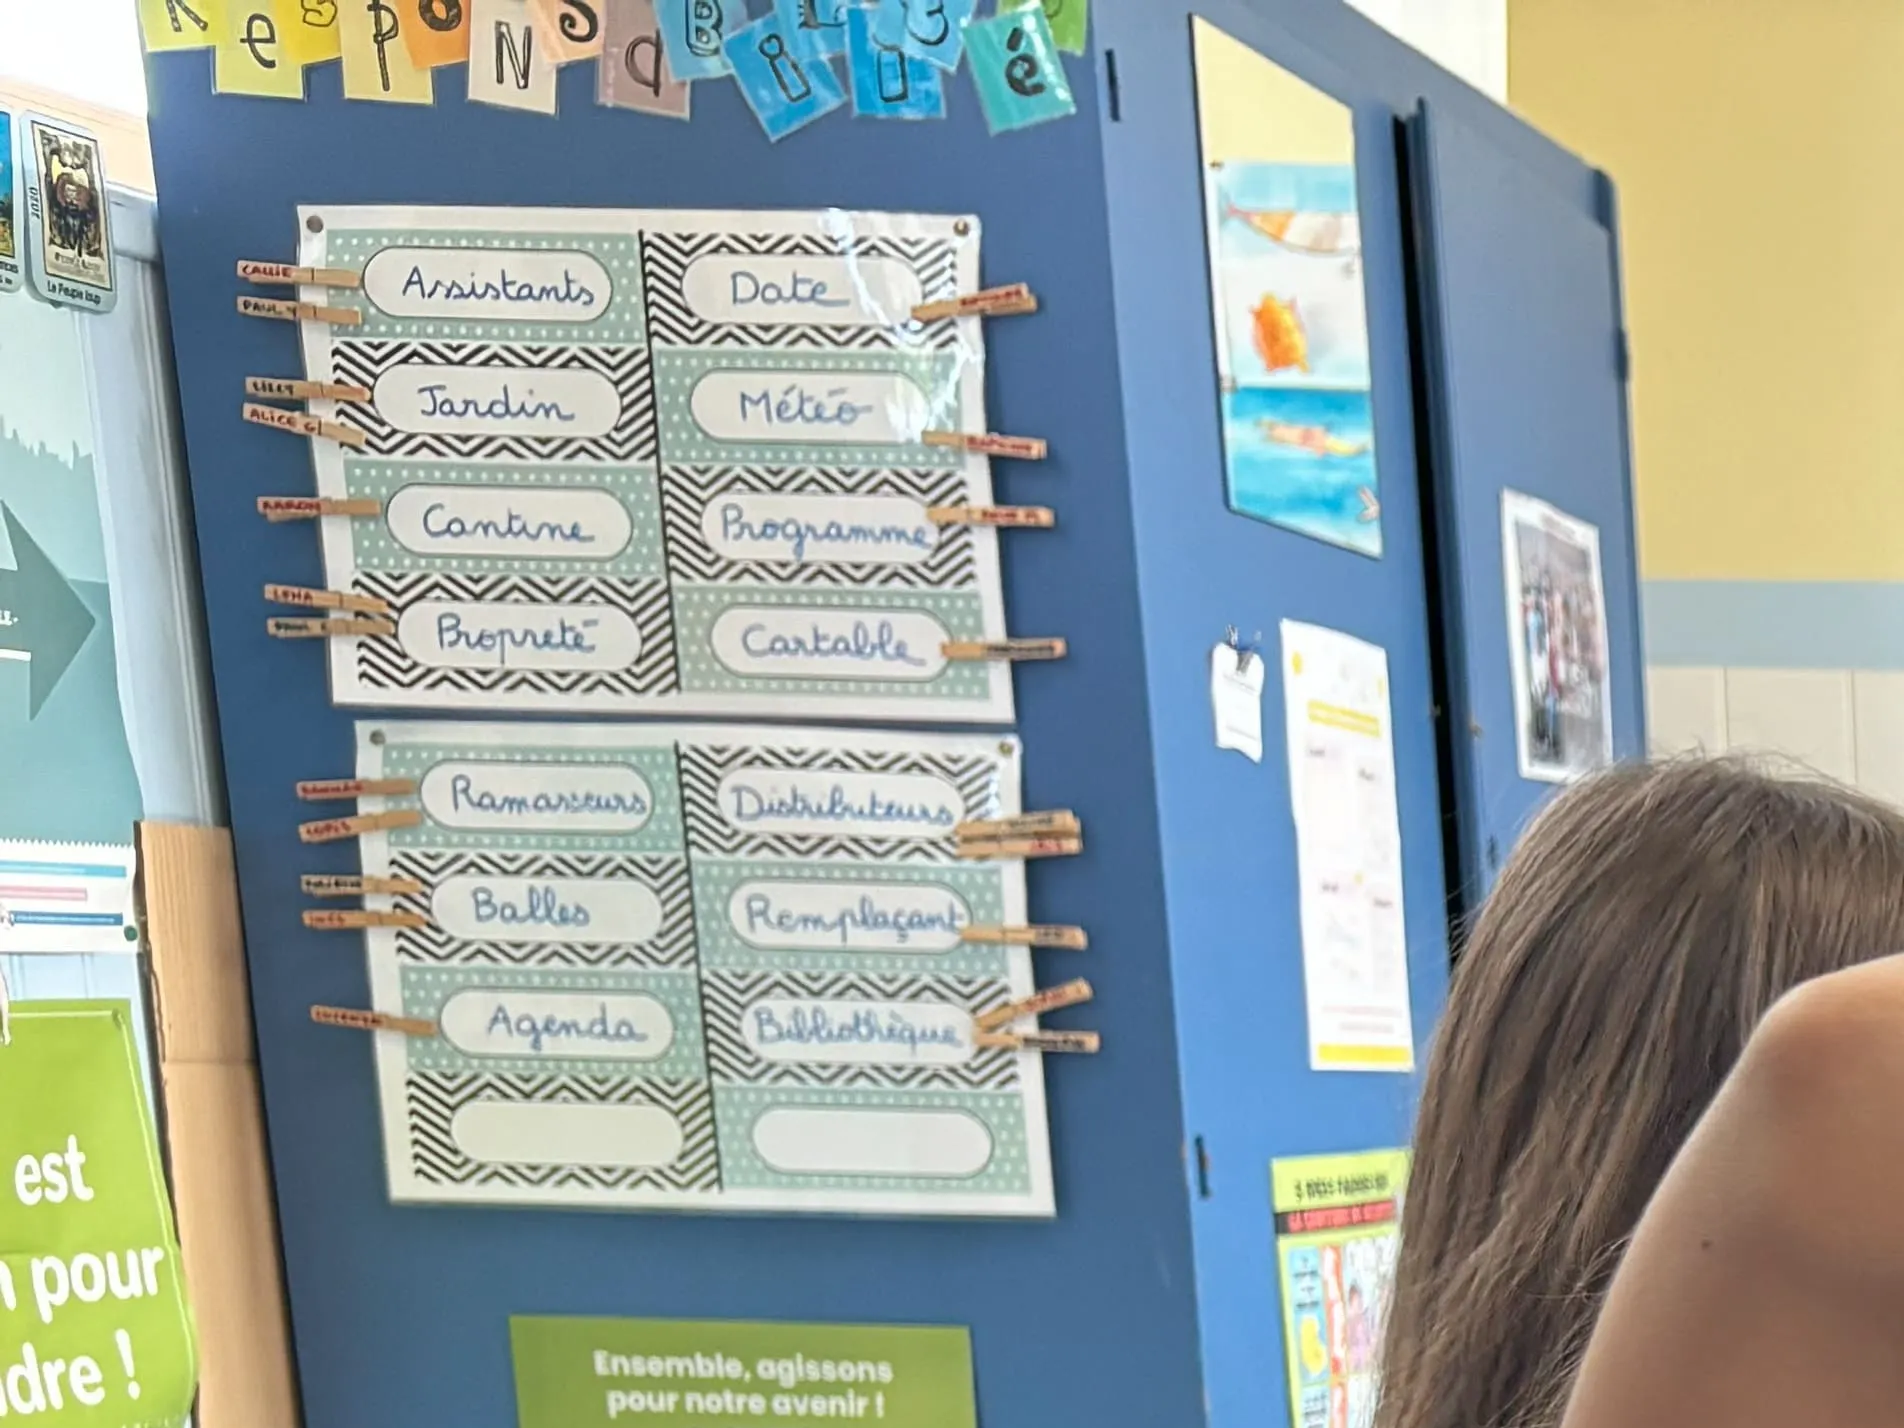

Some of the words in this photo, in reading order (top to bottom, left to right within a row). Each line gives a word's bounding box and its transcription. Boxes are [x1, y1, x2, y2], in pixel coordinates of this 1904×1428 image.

[401, 264, 595, 306] Assistants
[730, 270, 851, 307] Date
[417, 383, 575, 422] Jardin
[739, 383, 874, 426] Météo
[422, 503, 597, 544] Cantine
[721, 502, 932, 562] Programme
[437, 611, 600, 669] Propreté
[741, 621, 927, 667] Cartable
[451, 773, 647, 814] Ramasseurs
[730, 783, 955, 826] Distributeurs
[472, 885, 591, 928] Balles
[745, 891, 960, 943] Remplaçant
[486, 1001, 649, 1053] Agenda
[753, 1005, 963, 1058] Bibliothèque
[15, 1133, 95, 1207] est
[31, 1244, 165, 1325] pour
[0, 1340, 105, 1418] dre
[114, 1328, 142, 1400] !
[592, 1348, 752, 1384] Ensemble,
[756, 1352, 894, 1389] agissons
[605, 1388, 680, 1420] pour
[685, 1390, 766, 1417] notre
[771, 1391, 869, 1418] avenir
[876, 1390, 886, 1418] !
